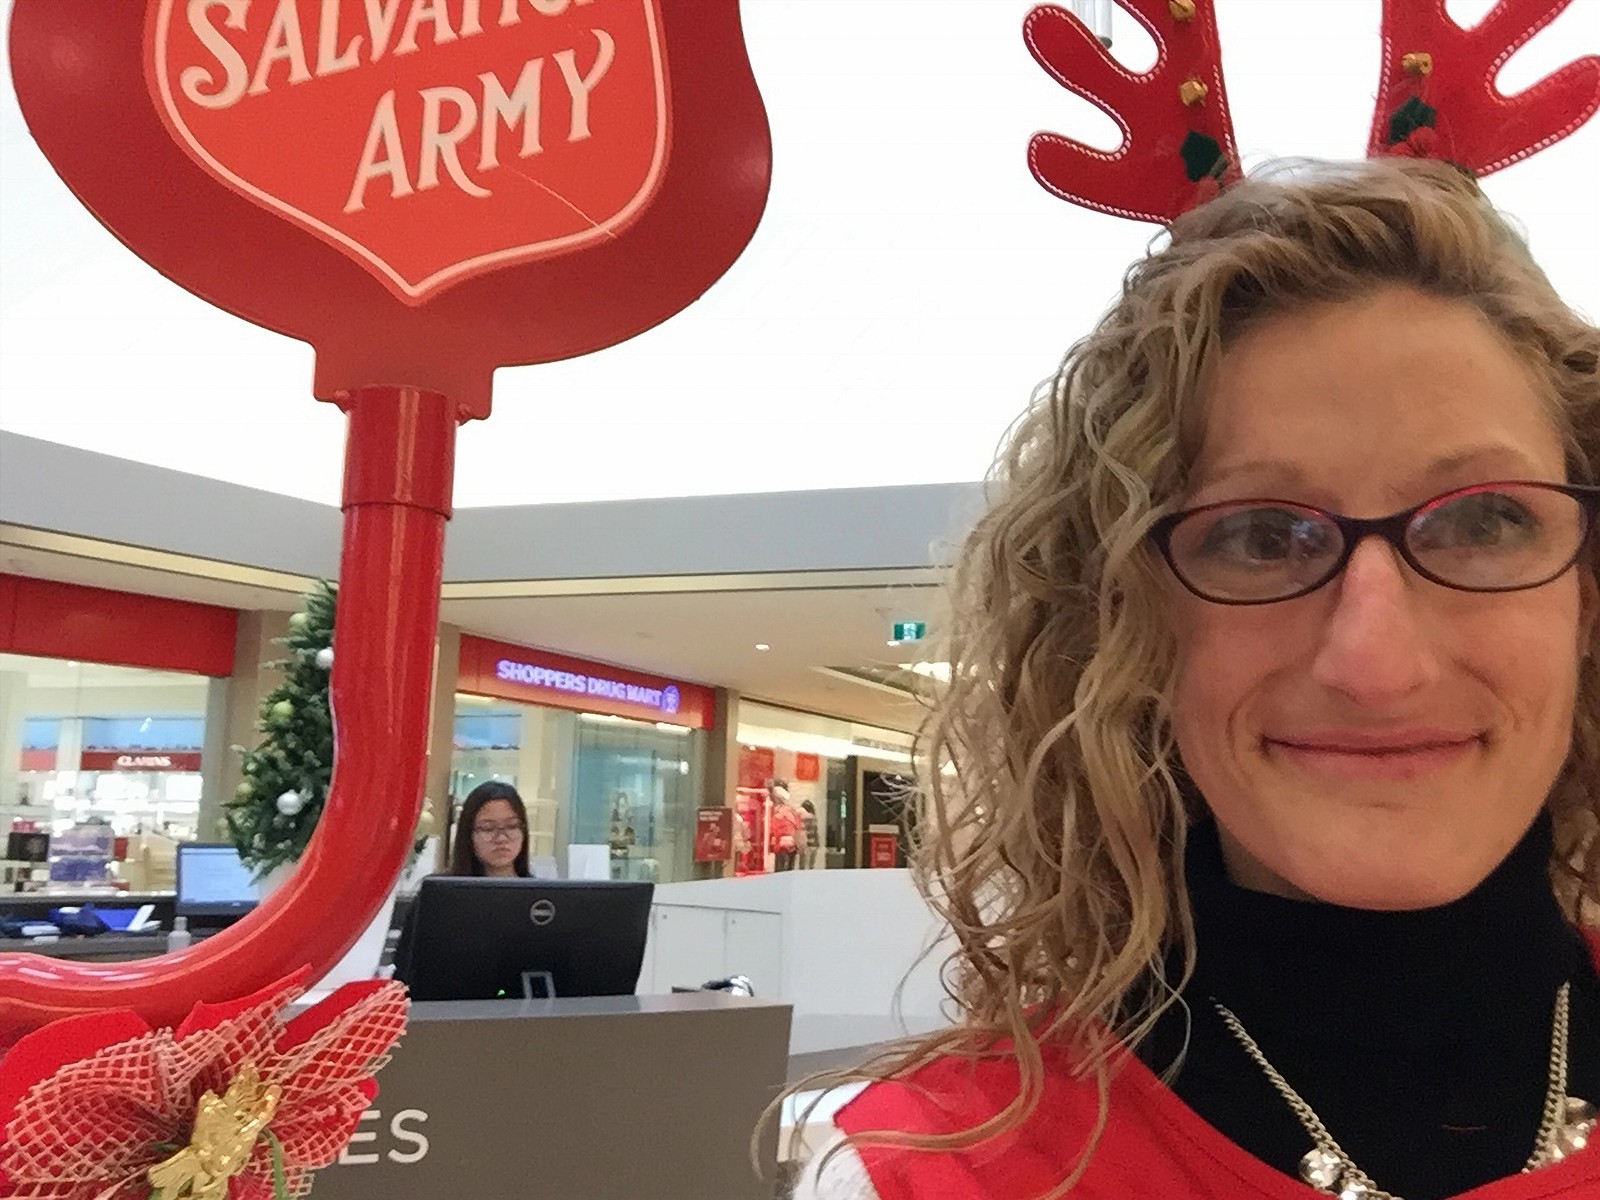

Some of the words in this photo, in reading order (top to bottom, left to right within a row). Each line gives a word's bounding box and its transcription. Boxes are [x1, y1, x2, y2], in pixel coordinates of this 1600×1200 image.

[342, 28, 616, 214] ARMY
[496, 659, 587, 693] SHOPPERS
[587, 676, 627, 700] DRUG
